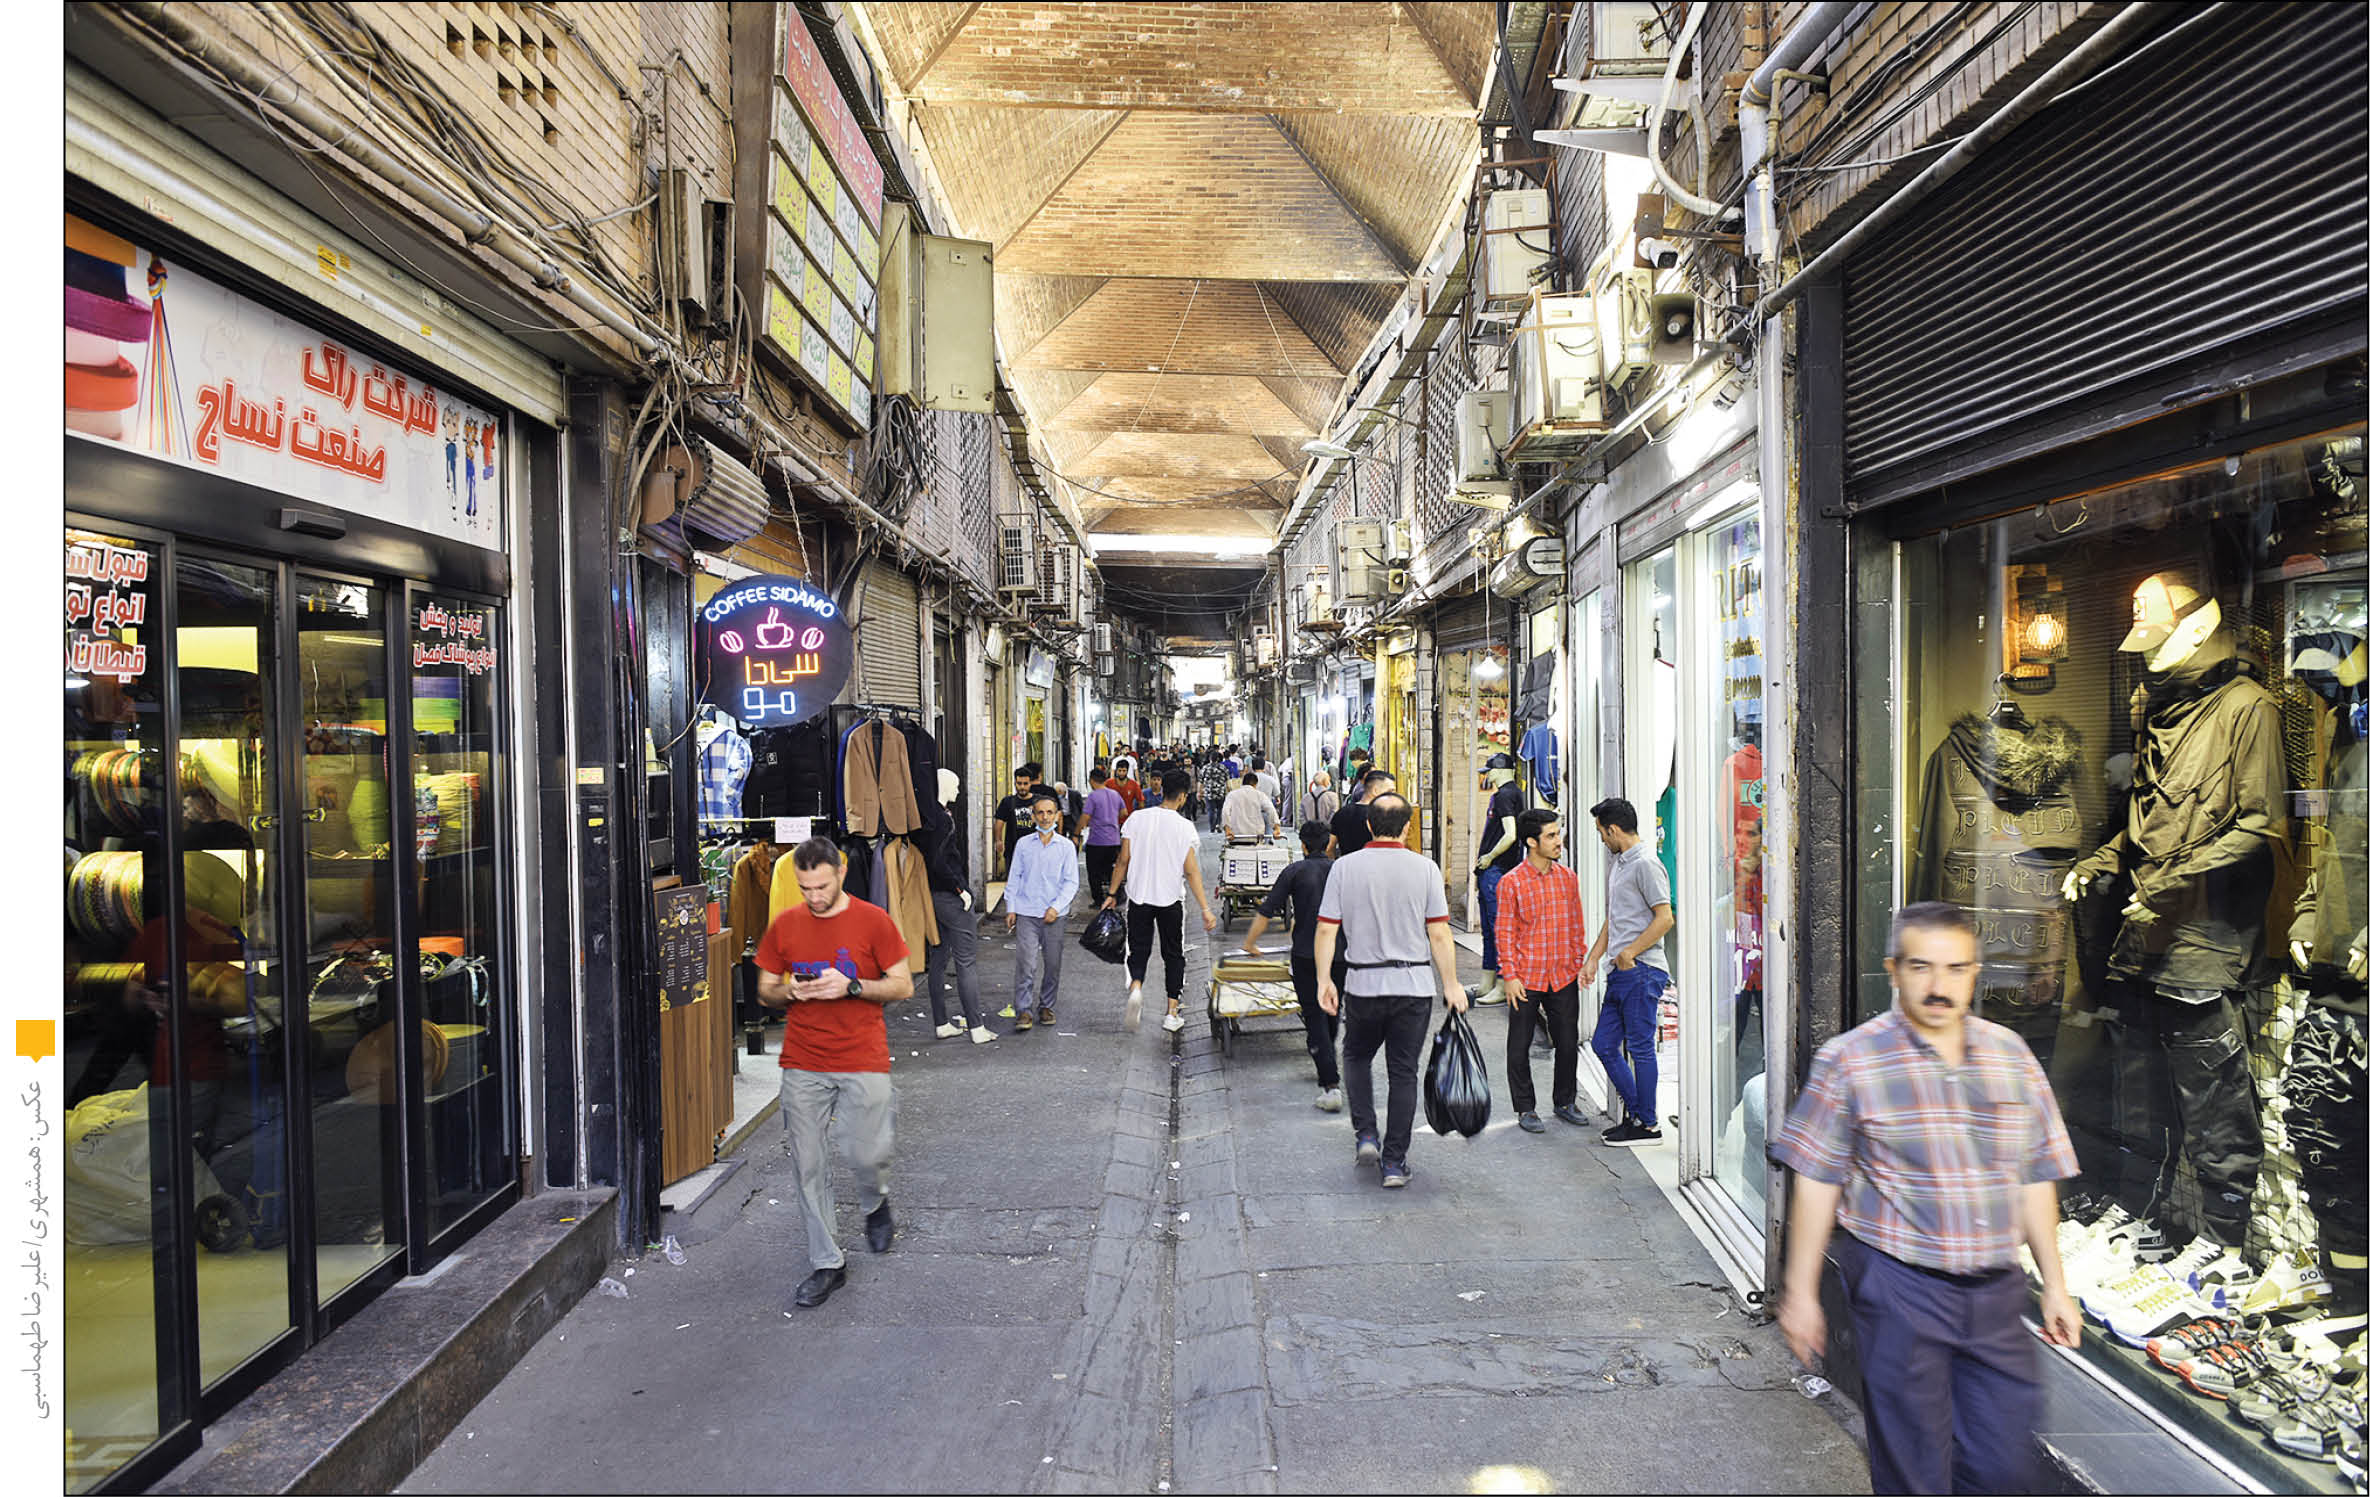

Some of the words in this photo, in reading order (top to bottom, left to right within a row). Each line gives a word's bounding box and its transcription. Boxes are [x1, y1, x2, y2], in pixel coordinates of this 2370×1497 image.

[302, 342, 358, 412] راک
[363, 364, 439, 436] شرکت
[195, 379, 286, 464] نساج
[289, 406, 387, 484] صنعت
[91, 546, 148, 587] قبول
[705, 587, 767, 622] COFFEE
[770, 586, 835, 618] SIDAMO
[1712, 557, 1762, 623] RIT
[93, 590, 146, 636] انواع
[419, 601, 448, 638] پخش
[448, 616, 457, 637] و
[457, 614, 483, 638] تولید
[72, 634, 146, 684] قیطان
[413, 642, 441, 668] فصل
[441, 640, 476, 674] پوشاک
[475, 646, 497, 675] انواع
[742, 686, 797, 721] مو
[1952, 808, 2081, 844] PLEIN
